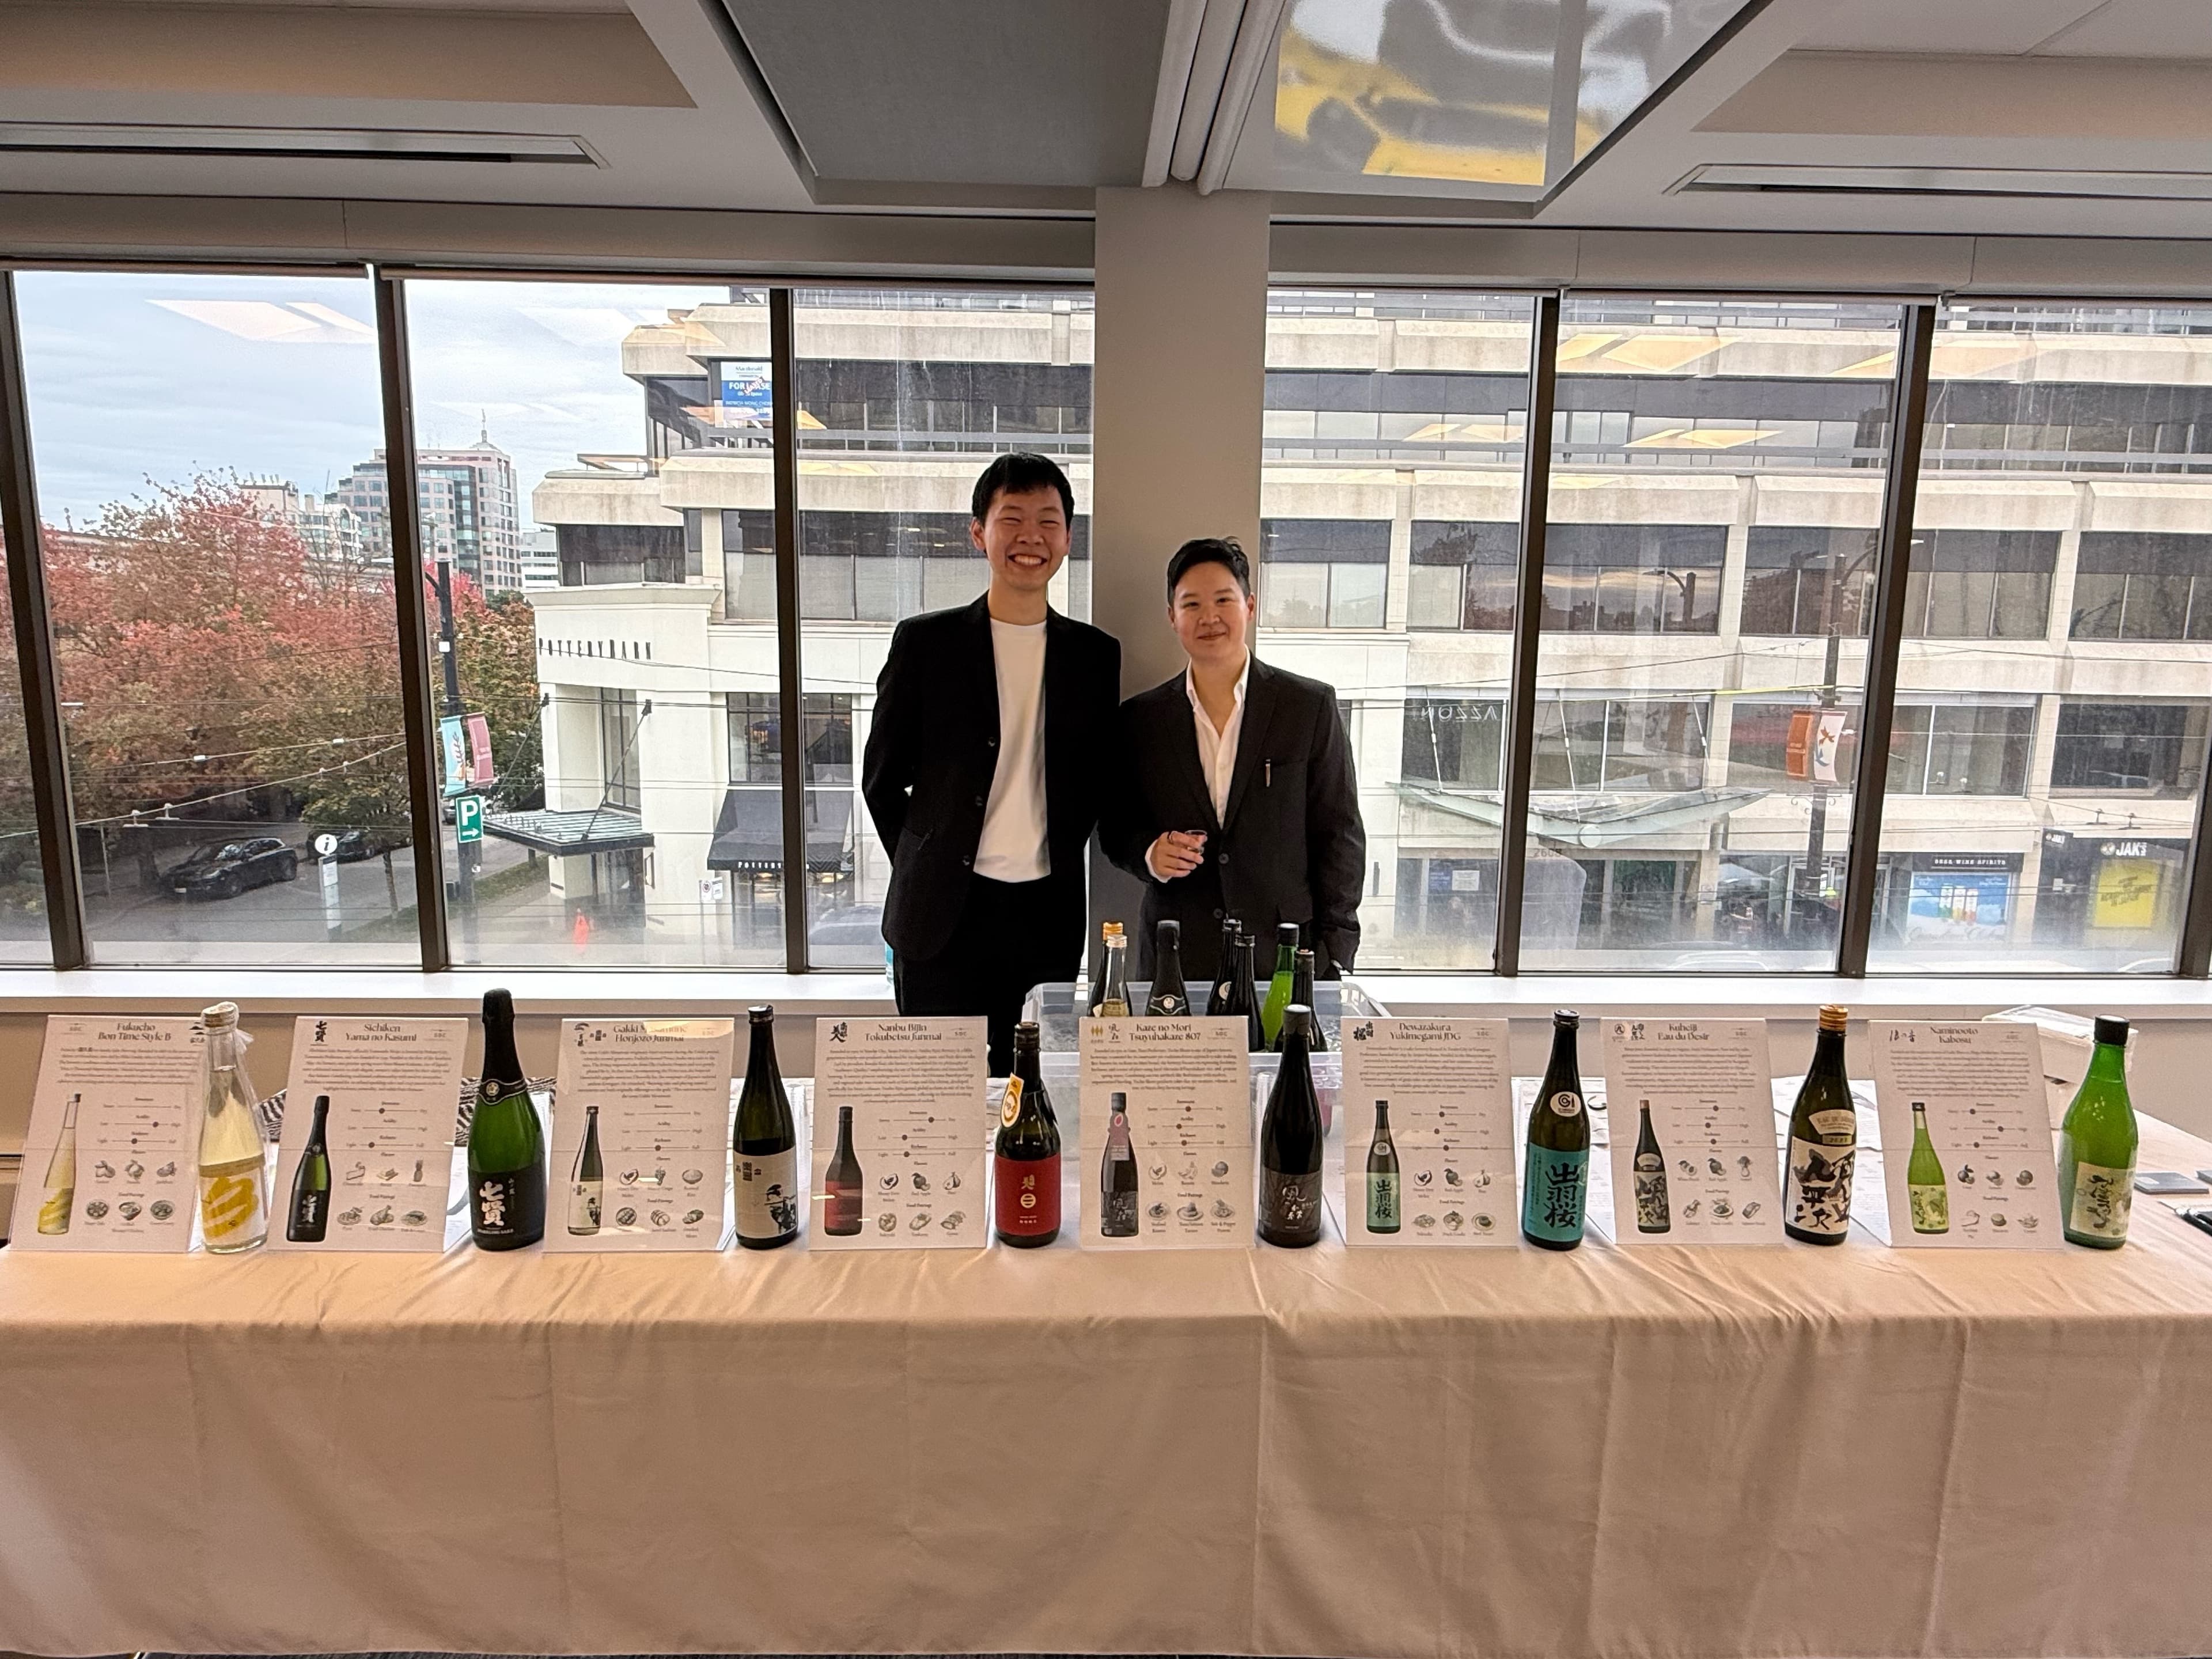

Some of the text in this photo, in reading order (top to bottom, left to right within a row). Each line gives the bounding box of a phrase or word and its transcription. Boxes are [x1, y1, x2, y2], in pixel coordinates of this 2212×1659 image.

[461, 800, 478, 825] P
[117, 1022, 156, 1031] Fukucho
[364, 1023, 401, 1032] Sichiken
[613, 1025, 638, 1033] Gakki
[908, 1023, 927, 1032] Bijin
[1399, 1022, 1451, 1031] Dewazakura
[1930, 1027, 1979, 1035] Naminooto
[118, 1032, 140, 1040] Time
[143, 1032, 164, 1043] Style
[165, 1033, 172, 1041] B
[346, 1033, 370, 1041] Yama
[385, 1033, 416, 1041] Kasumi
[615, 1034, 652, 1044] Honjozo
[866, 1032, 942, 1041] Tokubetsu Junmai
[1130, 1032, 1183, 1042] Tsuyuhakaze
[1186, 1032, 1201, 1041] 807
[1390, 1032, 1461, 1041] Yukimegami JDG
[1939, 1035, 1972, 1044] Kabosu
[1543, 1162, 1580, 1228] 出羽桜
[480, 1181, 505, 1226] 七賢
